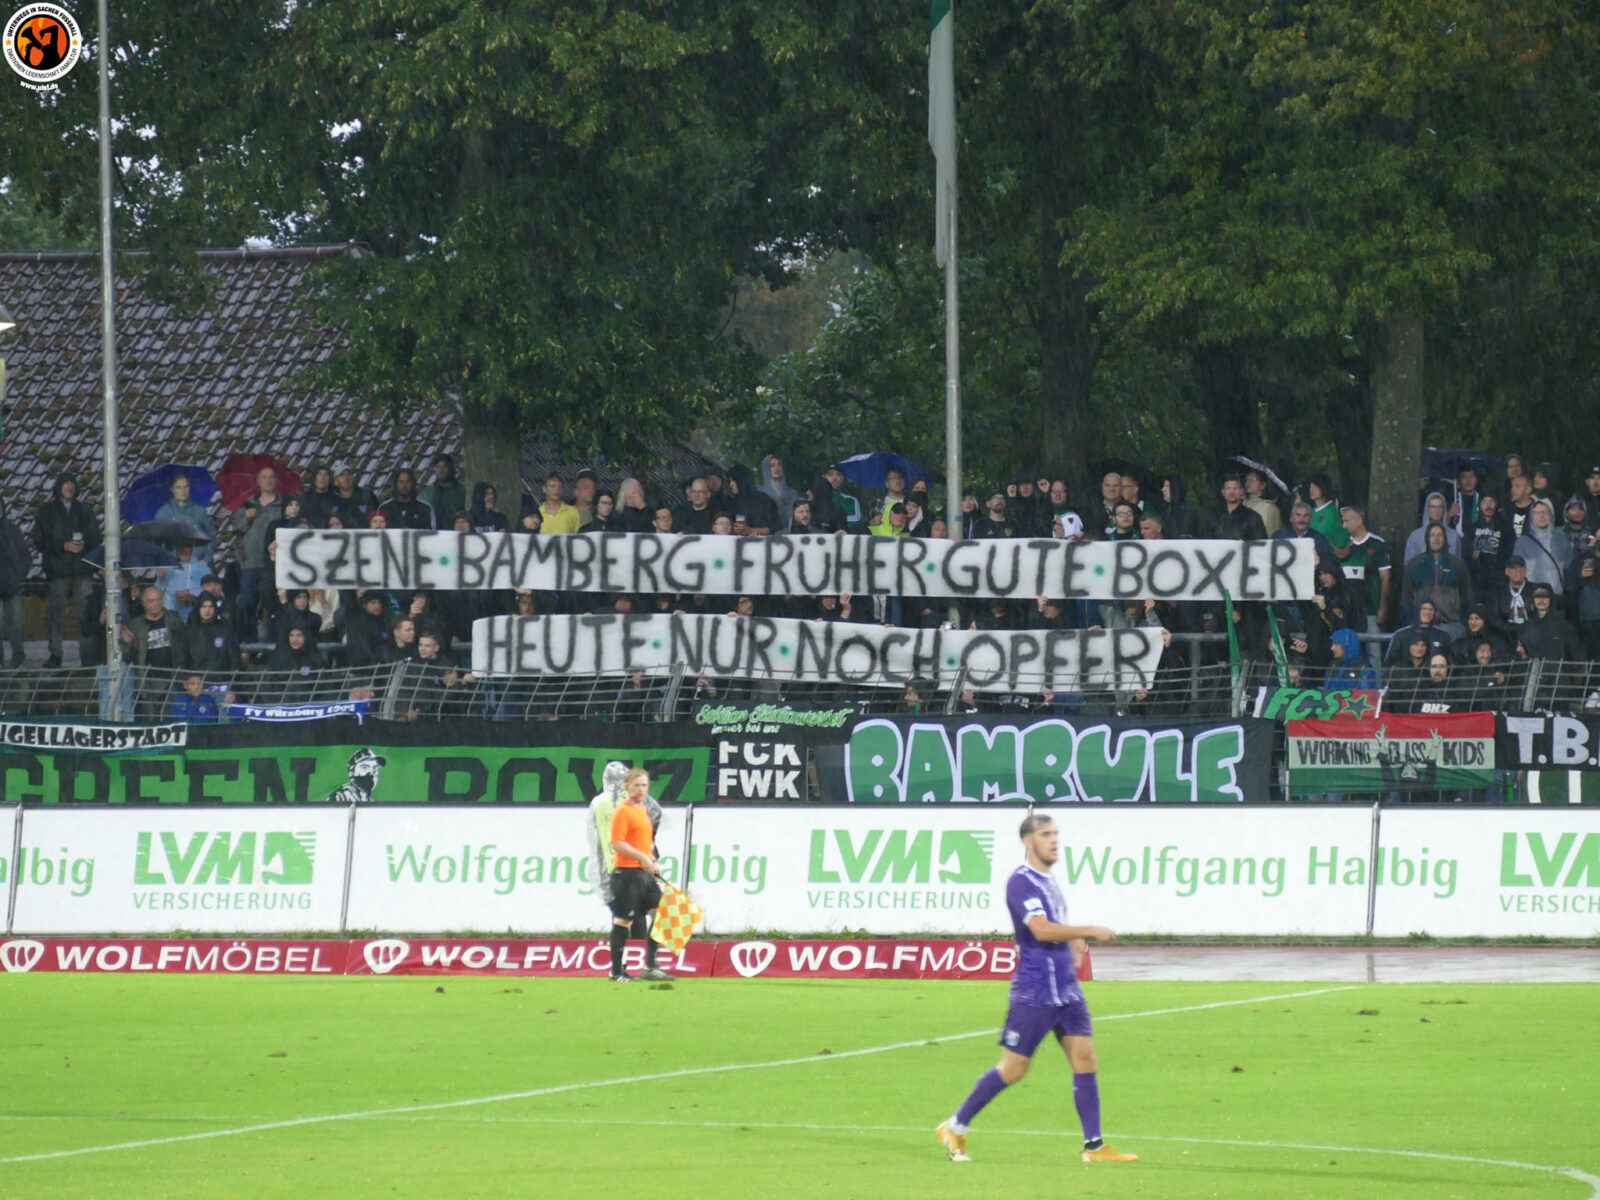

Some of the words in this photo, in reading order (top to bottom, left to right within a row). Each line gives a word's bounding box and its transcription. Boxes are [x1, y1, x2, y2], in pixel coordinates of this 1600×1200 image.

[288, 530, 437, 588] SZENE
[457, 532, 706, 592] BAMBERG
[734, 536, 927, 595] FRÜHER
[942, 541, 1090, 598] GUTE
[1113, 540, 1297, 599] BOXER
[488, 614, 652, 674] HEUTE
[671, 615, 778, 678] NUR
[797, 622, 941, 689] NOCH
[961, 629, 1150, 692] OPFER
[265, 707, 324, 718] Würzburg
[696, 704, 748, 725] Sektion
[1264, 687, 1353, 720] FCS
[711, 722, 743, 734] immer
[745, 722, 761, 733] bei
[763, 724, 780, 734] uns
[1506, 716, 1600, 765] T.B.
[719, 741, 801, 766] FCK
[845, 718, 1244, 801] BAMBULE
[1297, 740, 1371, 766] WORKING
[1388, 741, 1426, 765] CLASS
[1443, 741, 1485, 766] KIDS
[0, 754, 316, 802] GREEN
[718, 768, 800, 798] FWK
[134, 832, 256, 885] LVM
[658, 844, 768, 895] albig
[808, 830, 933, 883] LVM
[1064, 846, 1286, 897] Wolfgang
[1308, 846, 1458, 898] Halbig
[133, 892, 312, 910] VERSICHERUNG
[808, 890, 990, 909] VERSICHERUNG
[56, 942, 332, 972] WOLFMÖBEL
[421, 942, 697, 973] WOLFMÖBEL
[788, 942, 1018, 973] WOLFMÖB
